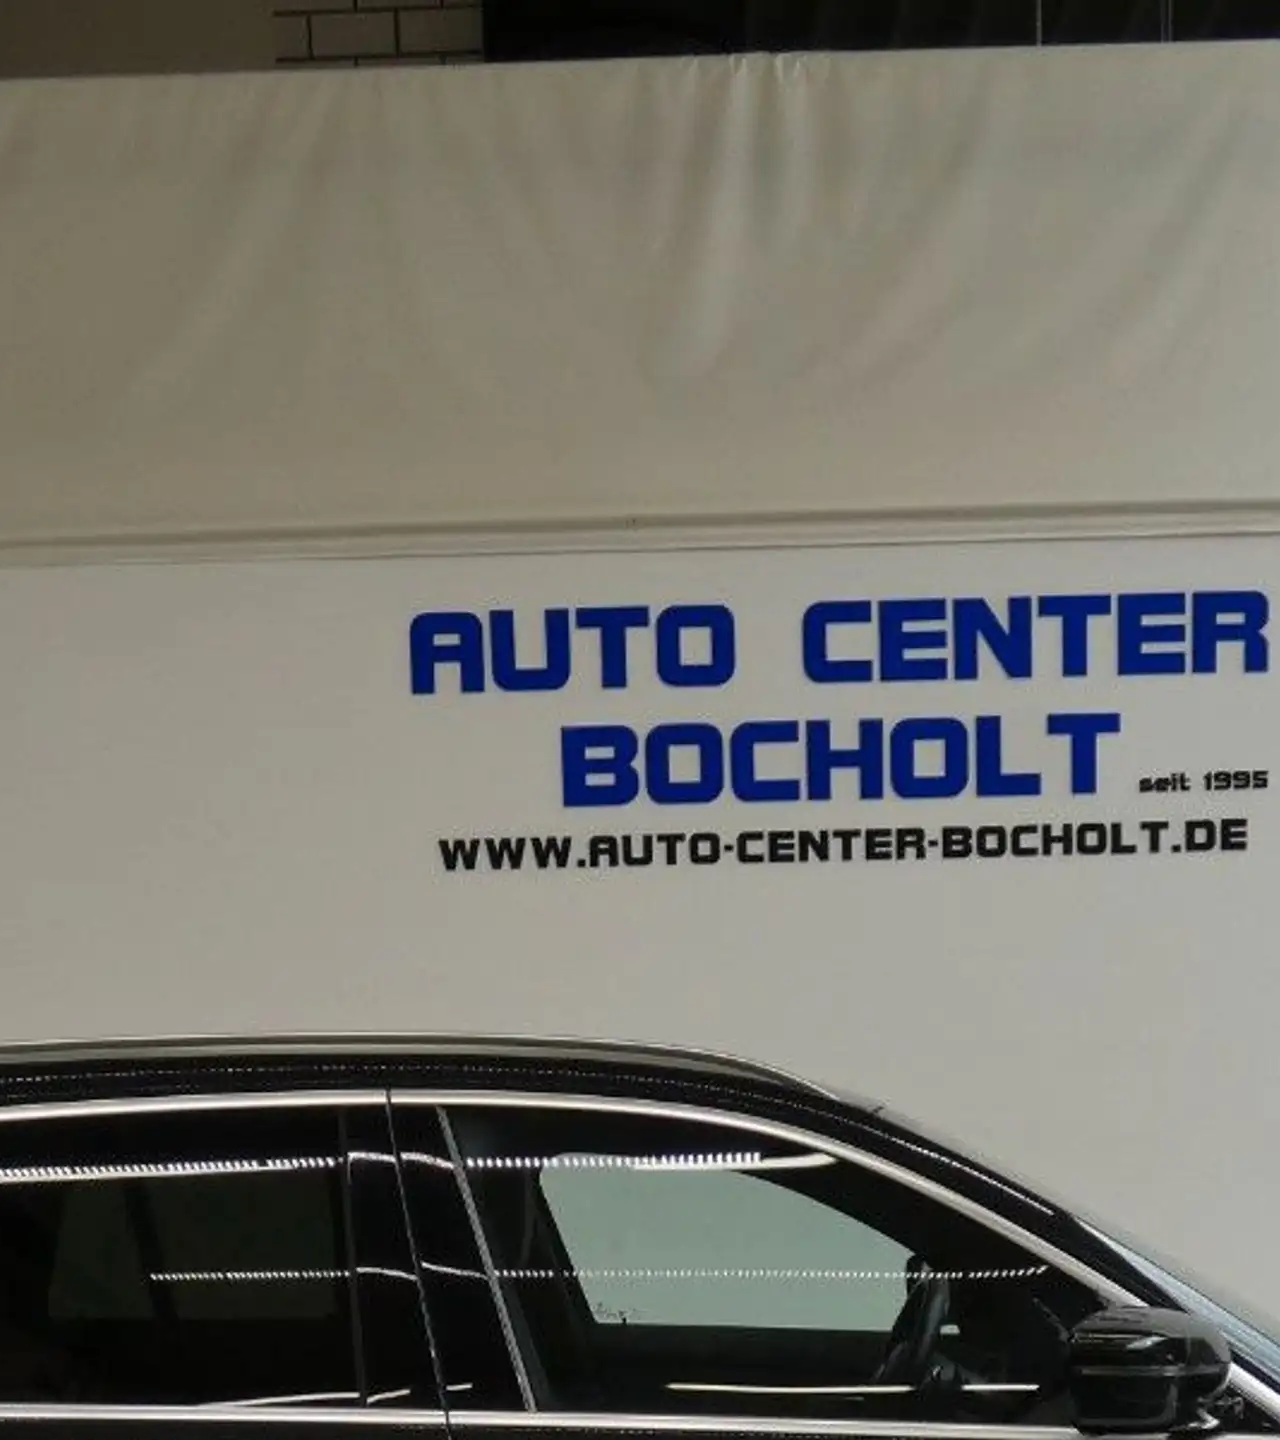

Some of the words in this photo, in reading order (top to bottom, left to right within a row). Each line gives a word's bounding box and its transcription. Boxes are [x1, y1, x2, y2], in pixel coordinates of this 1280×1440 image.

[410, 605, 736, 694] AUTO
[802, 590, 1270, 684] CENTER
[561, 713, 1121, 808] BOCHOLT
[1138, 772, 1191, 793] seit
[1203, 770, 1269, 791] 1995
[437, 818, 1248, 872] WWW.AUTO-CENTER-BOCHOLT.DE
